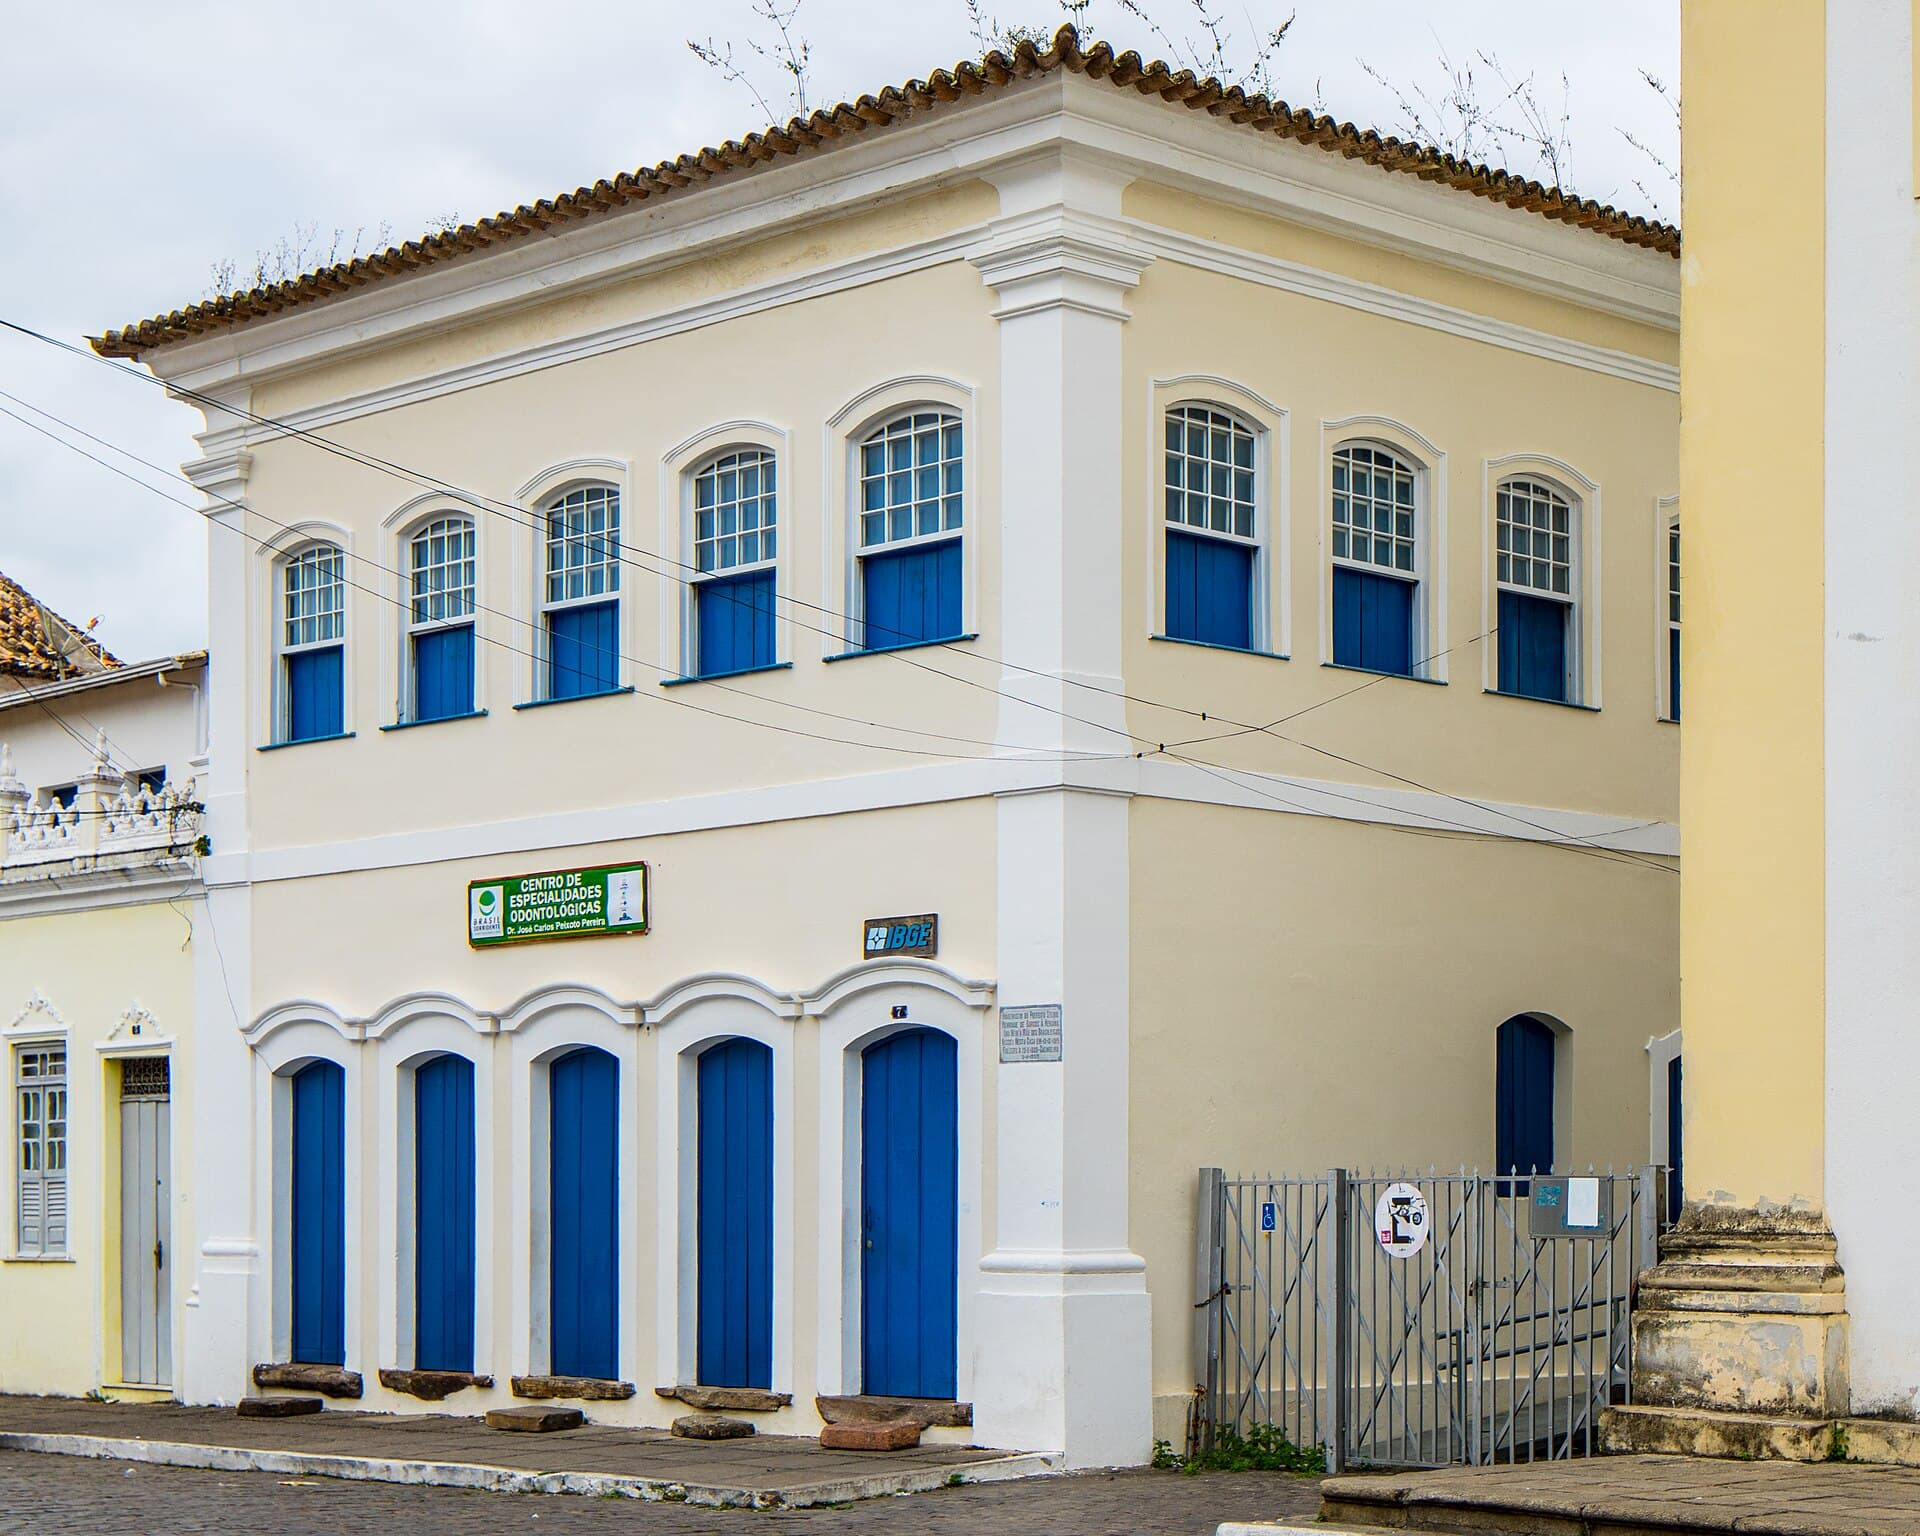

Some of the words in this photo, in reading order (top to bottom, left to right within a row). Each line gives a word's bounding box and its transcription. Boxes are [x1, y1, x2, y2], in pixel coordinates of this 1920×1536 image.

[521, 875, 564, 893] CENTRO
[566, 873, 582, 887] DE
[509, 885, 602, 908] ESPECIALIDADES
[473, 916, 500, 925] BRASIL
[510, 900, 601, 923] ODONTOLÓGICAS
[507, 926, 516, 935] Dr.
[517, 923, 533, 934] José
[533, 922, 555, 933] Carlos
[555, 920, 581, 931] Peixoto
[581, 918, 606, 928] Pereira
[885, 922, 932, 949] IBGE
